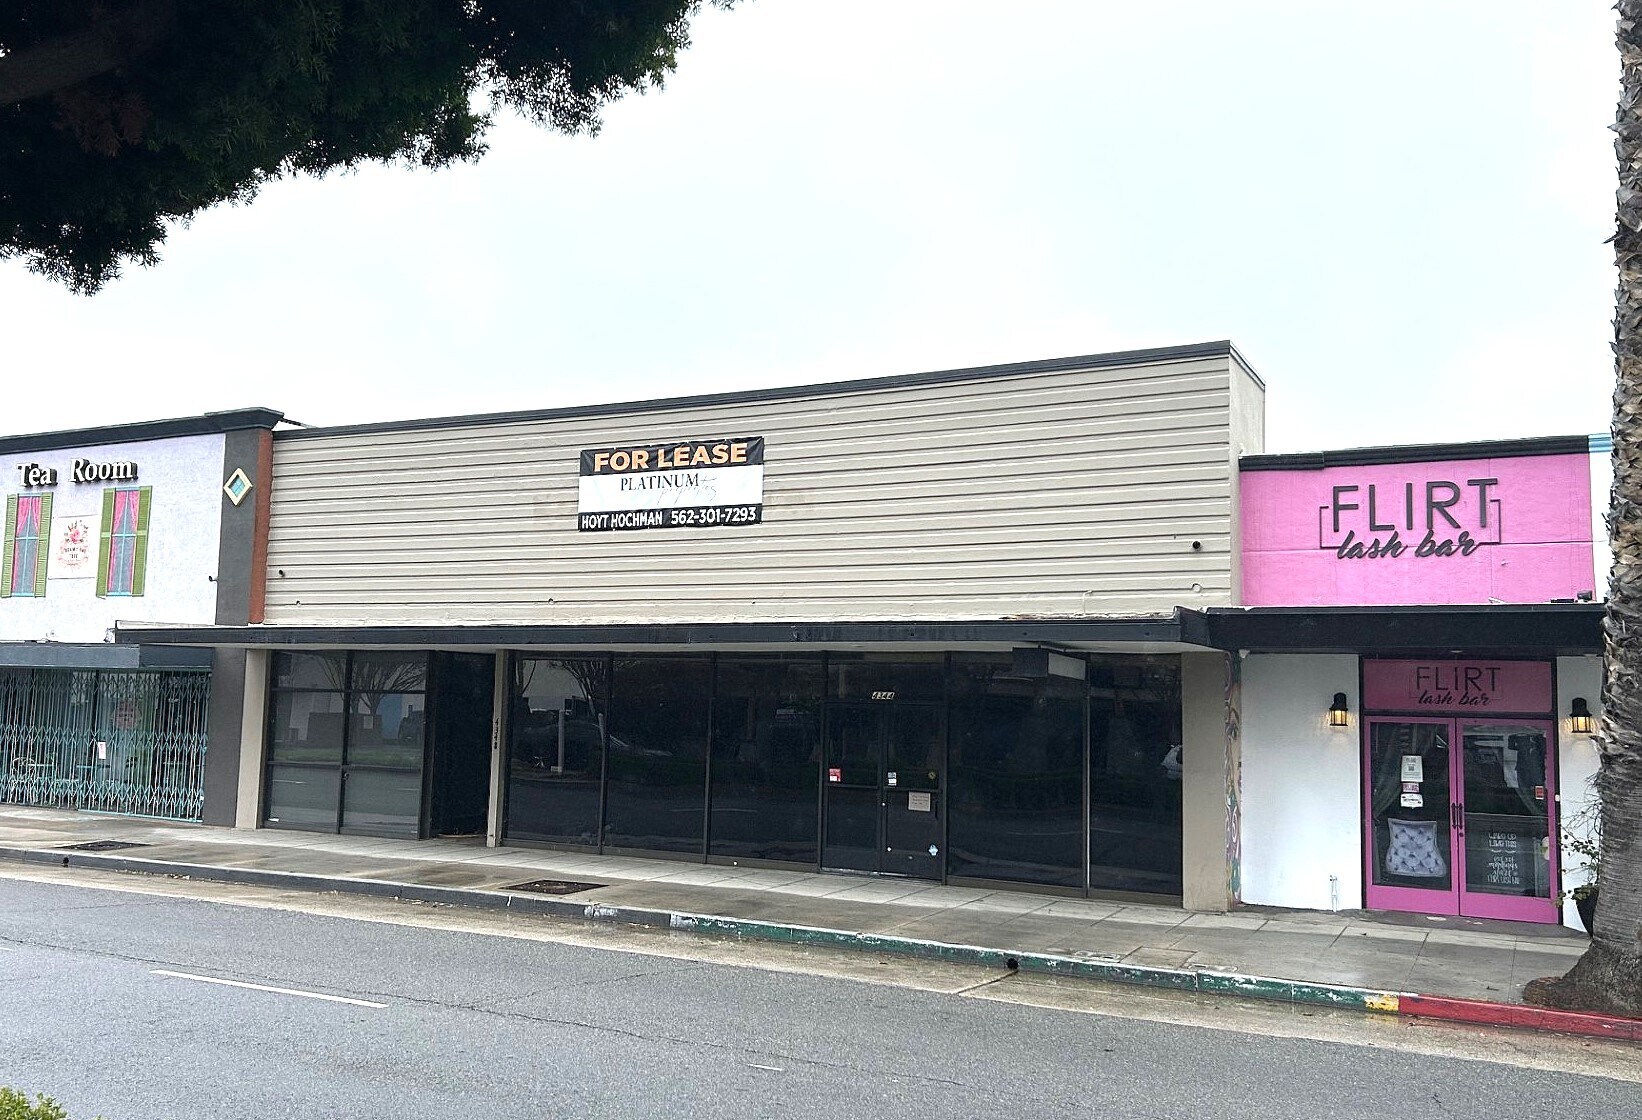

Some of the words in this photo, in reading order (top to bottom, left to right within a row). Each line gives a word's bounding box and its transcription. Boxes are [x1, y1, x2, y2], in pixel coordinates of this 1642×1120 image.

[593, 450, 650, 473] FOR
[657, 443, 748, 469] LEASE
[17, 462, 57, 487] Tea
[69, 458, 138, 482] Room
[620, 472, 699, 491] PLATINUM
[581, 513, 609, 529] HOYT
[611, 511, 663, 527] HOCHMAN
[670, 506, 757, 525] 562-301-7293
[1332, 478, 1498, 532] FLIRT
[1337, 529, 1408, 559] lash
[1415, 528, 1479, 557] bar
[1416, 666, 1501, 691] FLIRT
[1418, 689, 1454, 705] lash
[1459, 691, 1491, 706] bar
